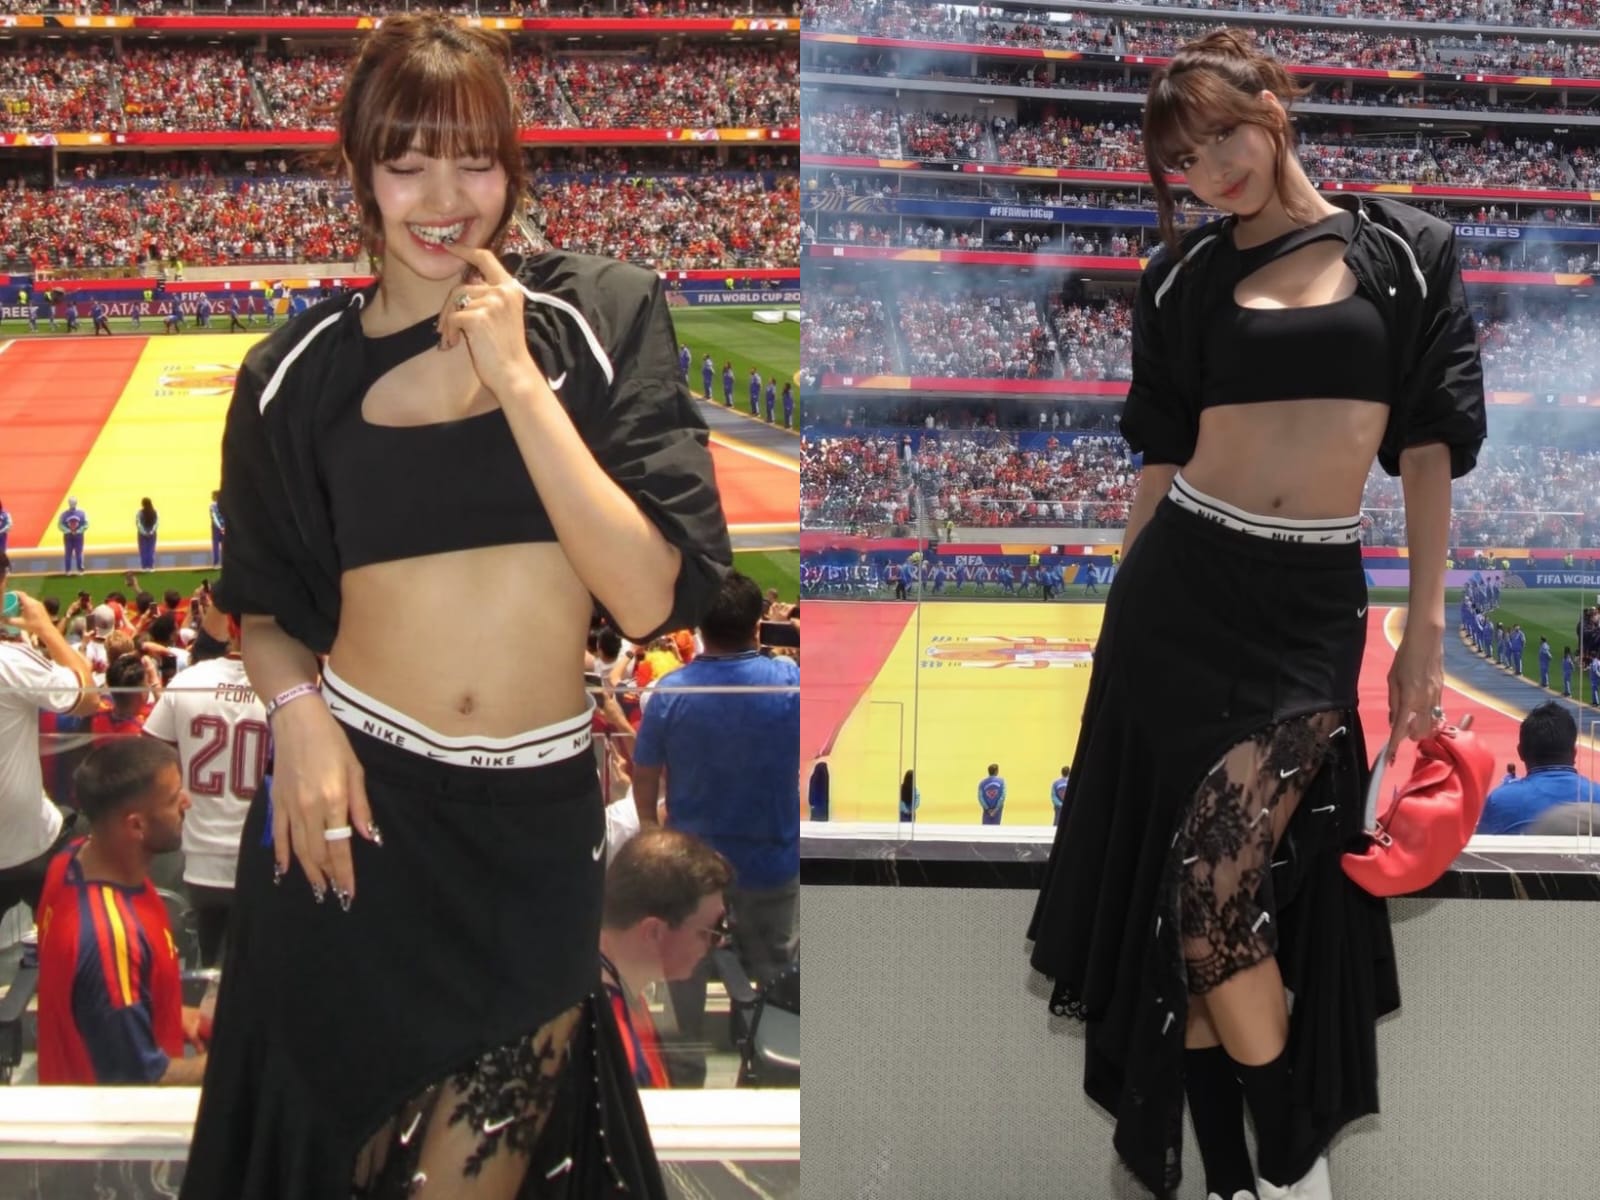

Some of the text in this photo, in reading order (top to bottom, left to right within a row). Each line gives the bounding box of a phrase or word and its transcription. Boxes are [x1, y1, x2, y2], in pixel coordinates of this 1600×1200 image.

[990, 206, 1054, 220] #FIFAWorldCup
[181, 292, 207, 300] FIFA
[698, 293, 721, 302] FIFA
[722, 293, 760, 302] WORLD
[761, 292, 782, 302] CUP
[1271, 532, 1304, 542] NIKE
[955, 555, 983, 566] FIFA
[1536, 574, 1561, 584] FIFA
[363, 720, 406, 747] NIKE
[188, 714, 269, 800] 20
[471, 755, 516, 766] NIKE
